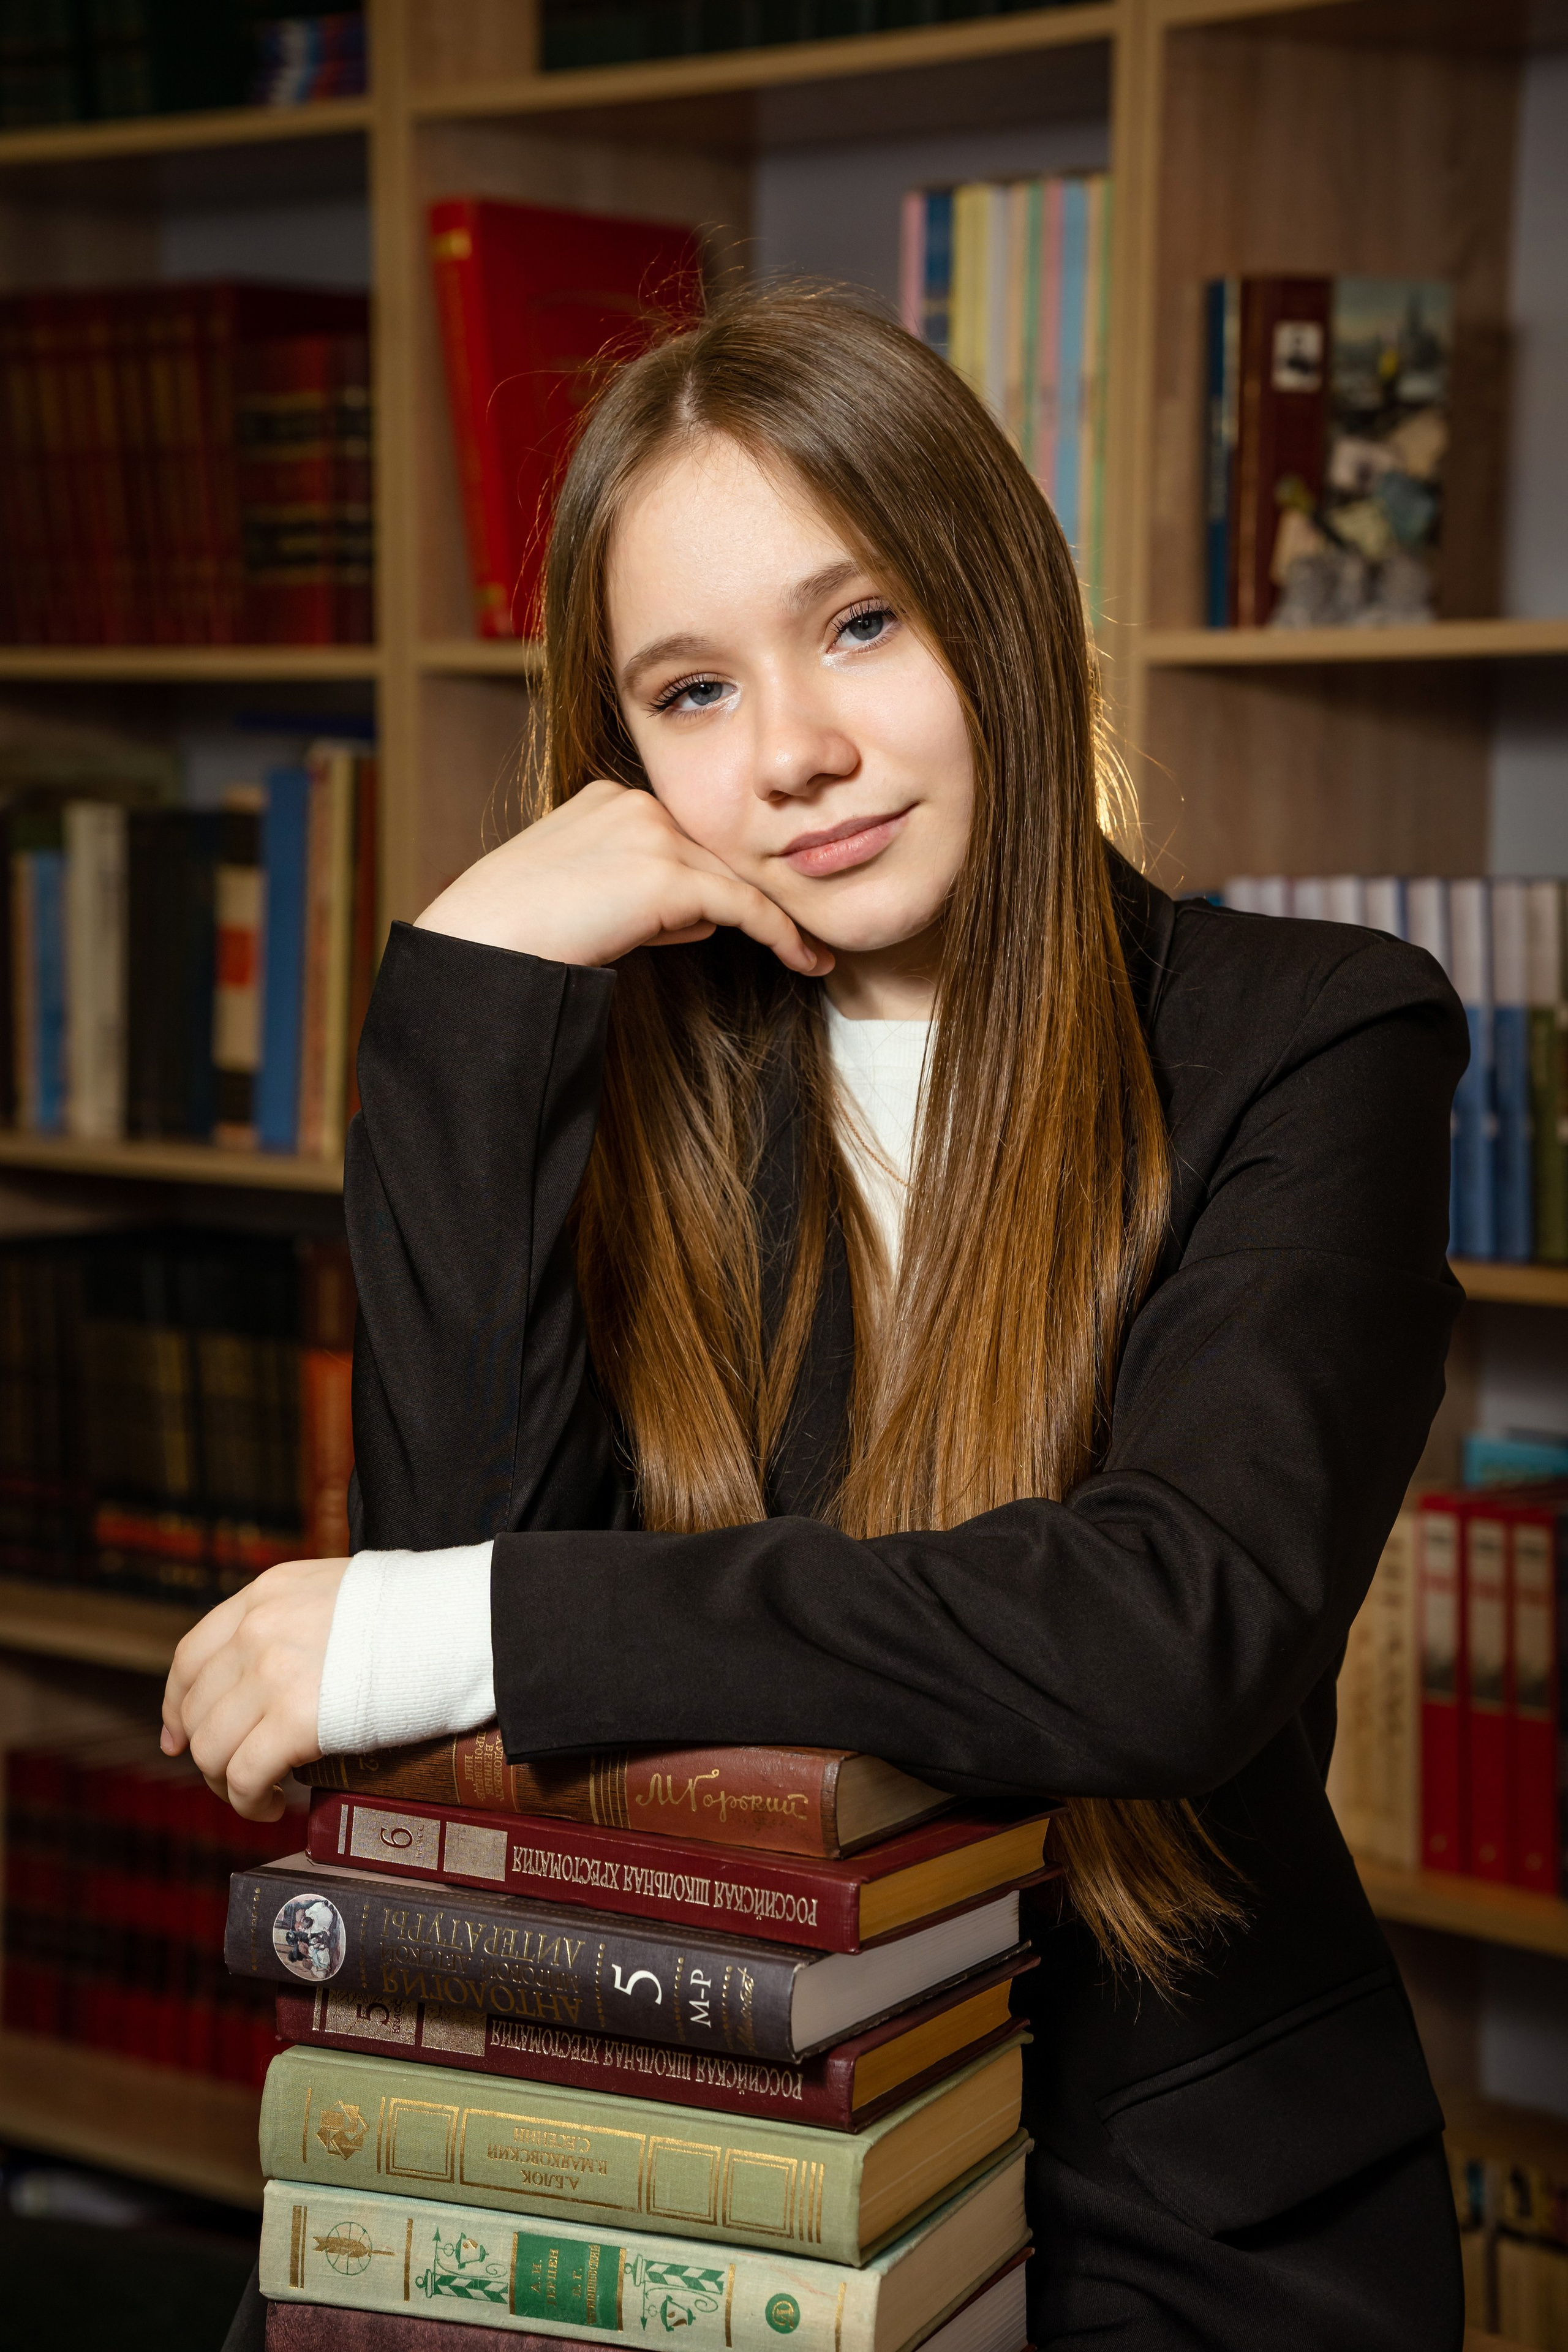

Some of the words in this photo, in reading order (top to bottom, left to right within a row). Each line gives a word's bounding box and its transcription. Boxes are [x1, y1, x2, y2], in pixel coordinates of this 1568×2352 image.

[464, 1754, 474, 1781] НИЯ
[484, 1743, 494, 1795] ВЕННЫЕ
[380, 1826, 413, 1849] 6
[511, 1845, 620, 1890] ХРЕСТОМАТИЯ
[623, 1865, 710, 1906] ШКОЛЬНАЯ
[713, 1880, 818, 1927] РОССИЙСКАЯ
[380, 1907, 586, 1968] ЛИТЕРАТУРЫ
[380, 1942, 472, 1973] ДЕТСКОЙ
[380, 1962, 583, 2024] АНТОЛОГИЯ
[481, 1959, 581, 1993] МИРОВОЙ
[611, 1963, 662, 2005] 5
[356, 2002, 390, 2026] 5
[490, 2019, 601, 2066] ХРЕСТОМАТИЯ
[603, 2039, 693, 2081] ШКОЛЬНАЯ
[696, 2055, 804, 2101] РОССИЙСКАЯ
[546, 2248, 559, 2307] ГЕРЦЕН
